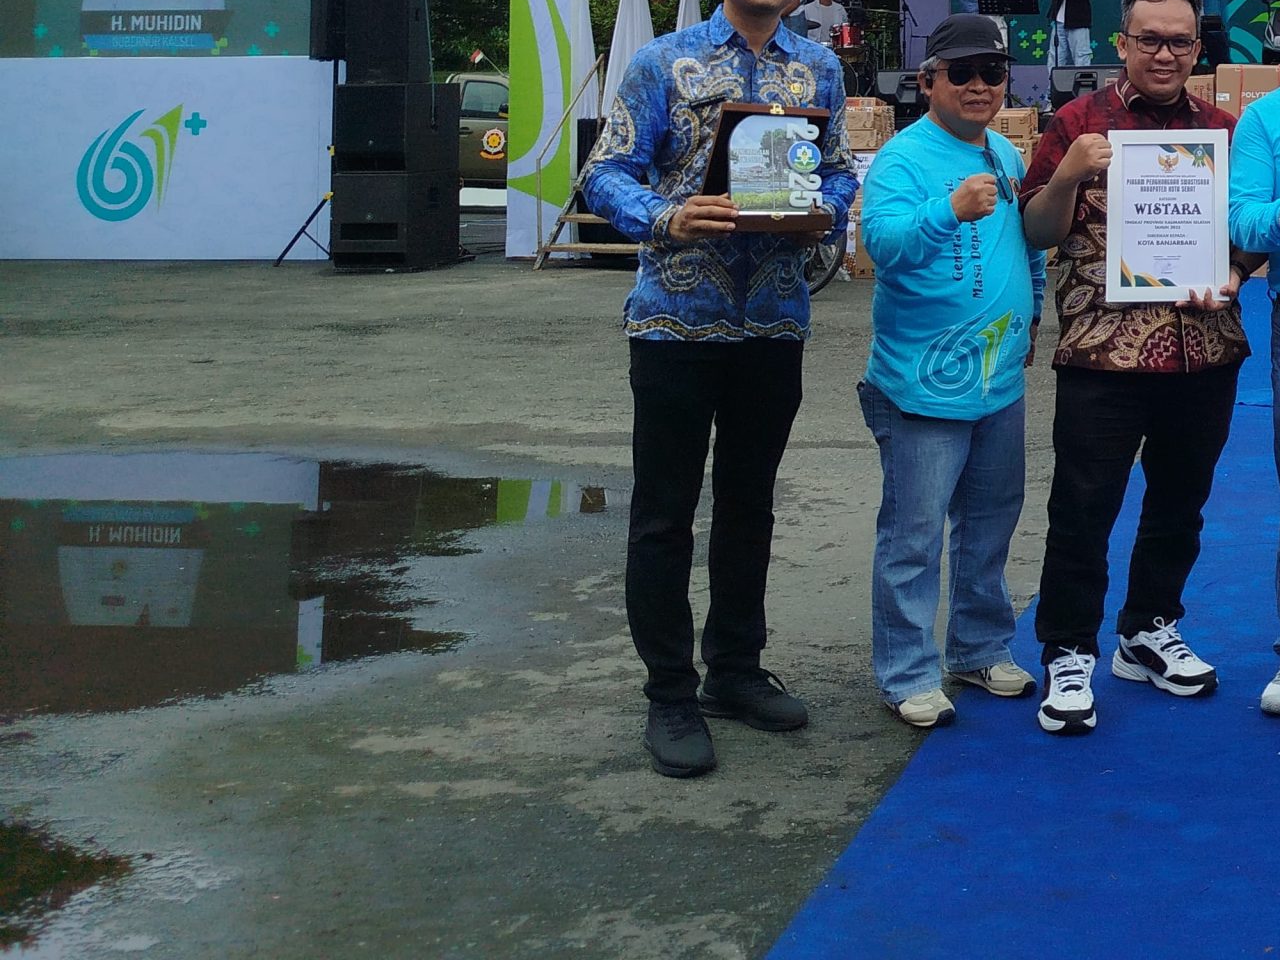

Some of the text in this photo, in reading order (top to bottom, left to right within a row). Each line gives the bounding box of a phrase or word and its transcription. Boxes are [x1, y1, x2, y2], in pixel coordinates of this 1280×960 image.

[111, 15, 202, 31] H. MUHIDIN
[1134, 202, 1202, 215] WISTARA
